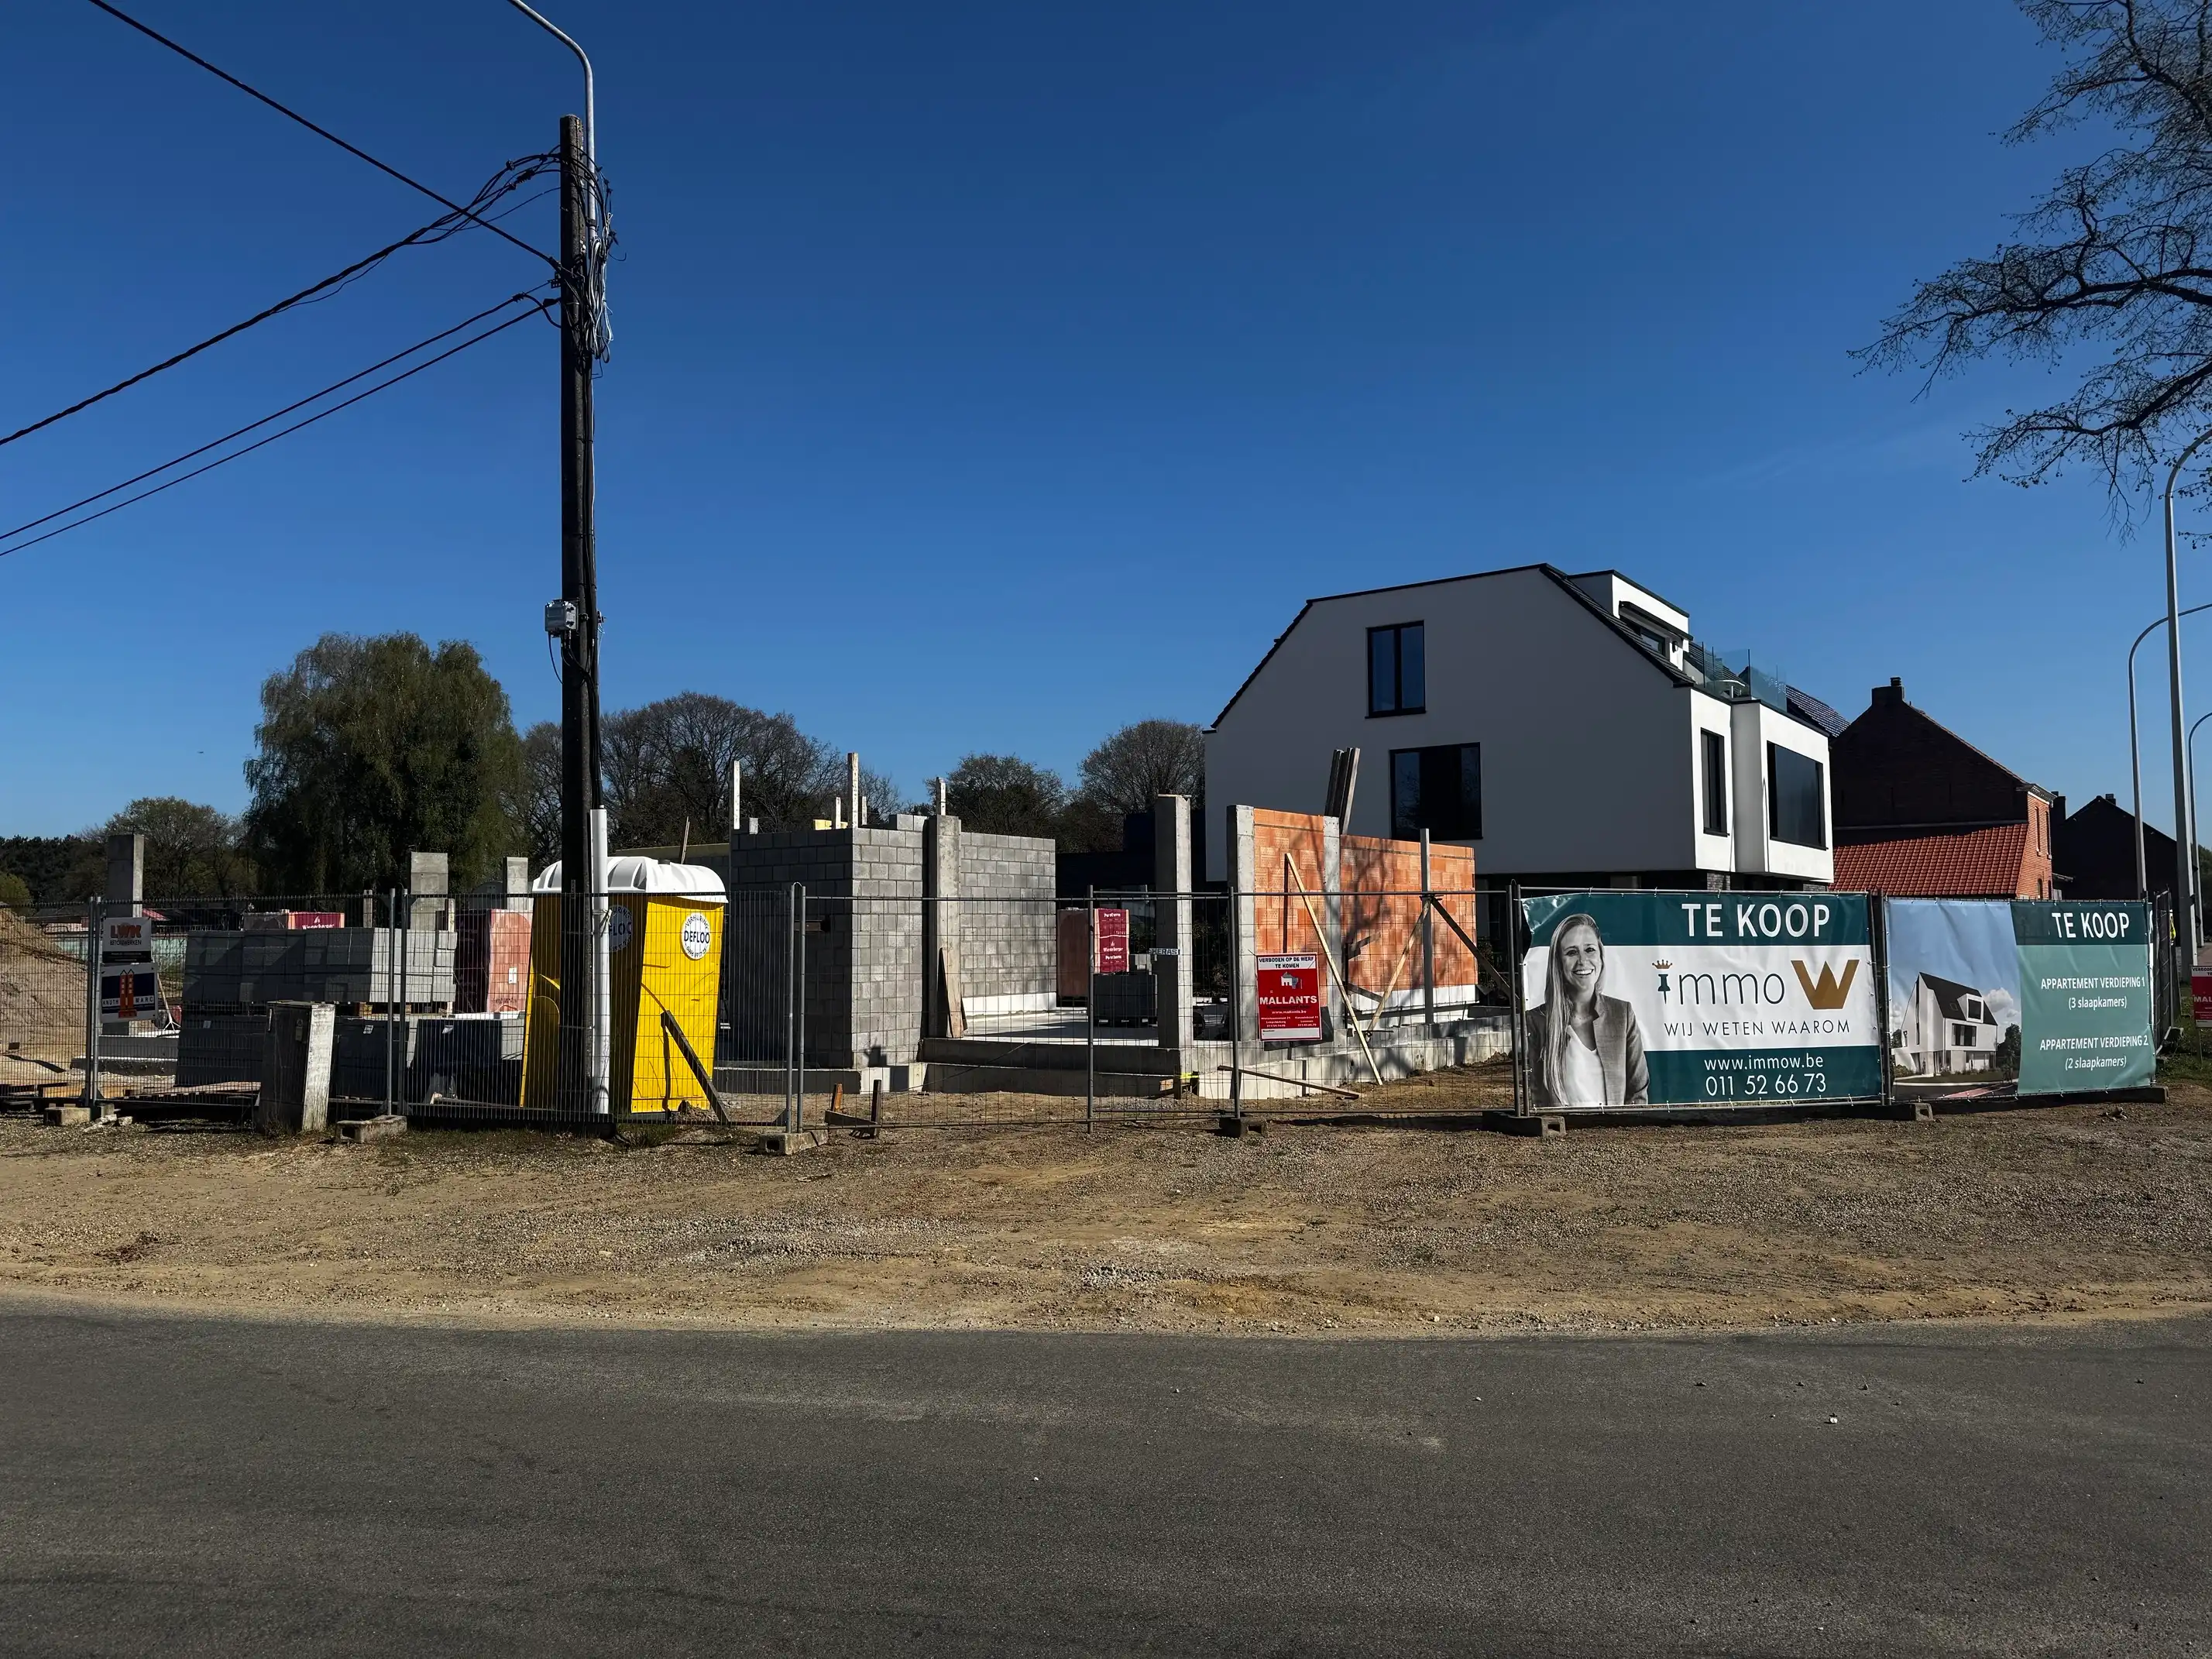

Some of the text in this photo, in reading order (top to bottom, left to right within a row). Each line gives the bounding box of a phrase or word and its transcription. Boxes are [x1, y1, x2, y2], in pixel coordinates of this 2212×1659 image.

[1681, 903, 1830, 937] TE KOOP
[2052, 912, 2129, 938] TE KOOP
[684, 931, 710, 944] DEFLOO
[2041, 977, 2145, 989] APPARTEMENT VERDIEPING 1
[1259, 995, 1317, 1005] MALLANTS
[2069, 996, 2127, 1011] (3 slaapkamers)
[1664, 1019, 1850, 1036] WIJ WETEN WAAROM
[2039, 1035, 2149, 1051] APPARTEMENT VERDIEPING 2
[1704, 1053, 1823, 1070] www.immow.be
[2065, 1056, 2127, 1070] (2 slaapkamers)
[1705, 1073, 1826, 1096] 011 52 66 73
